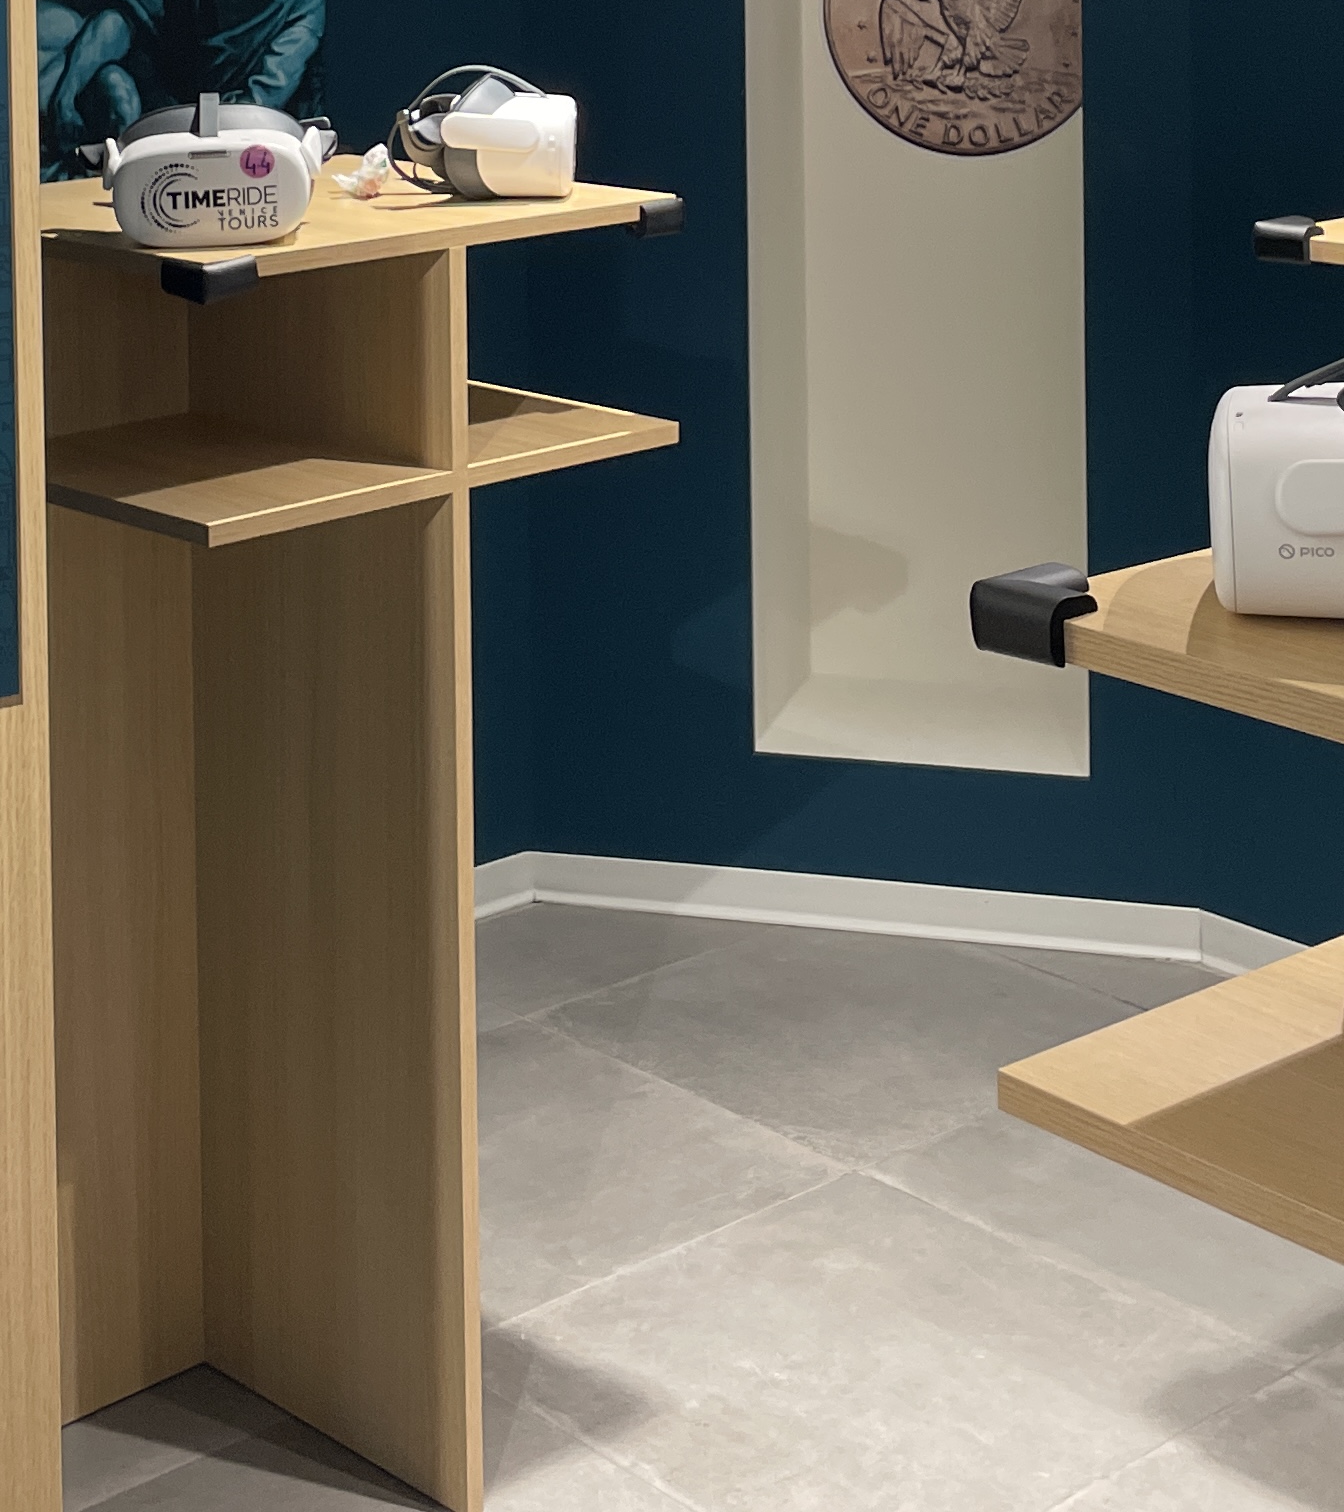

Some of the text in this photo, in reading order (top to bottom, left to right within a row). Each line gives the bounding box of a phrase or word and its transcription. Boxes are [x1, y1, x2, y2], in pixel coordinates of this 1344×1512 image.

[866, 86, 1074, 147] ONE DOLLAR
[217, 205, 278, 217] VENICE
[217, 214, 279, 231] TOURS
[1299, 546, 1335, 558] PICO
